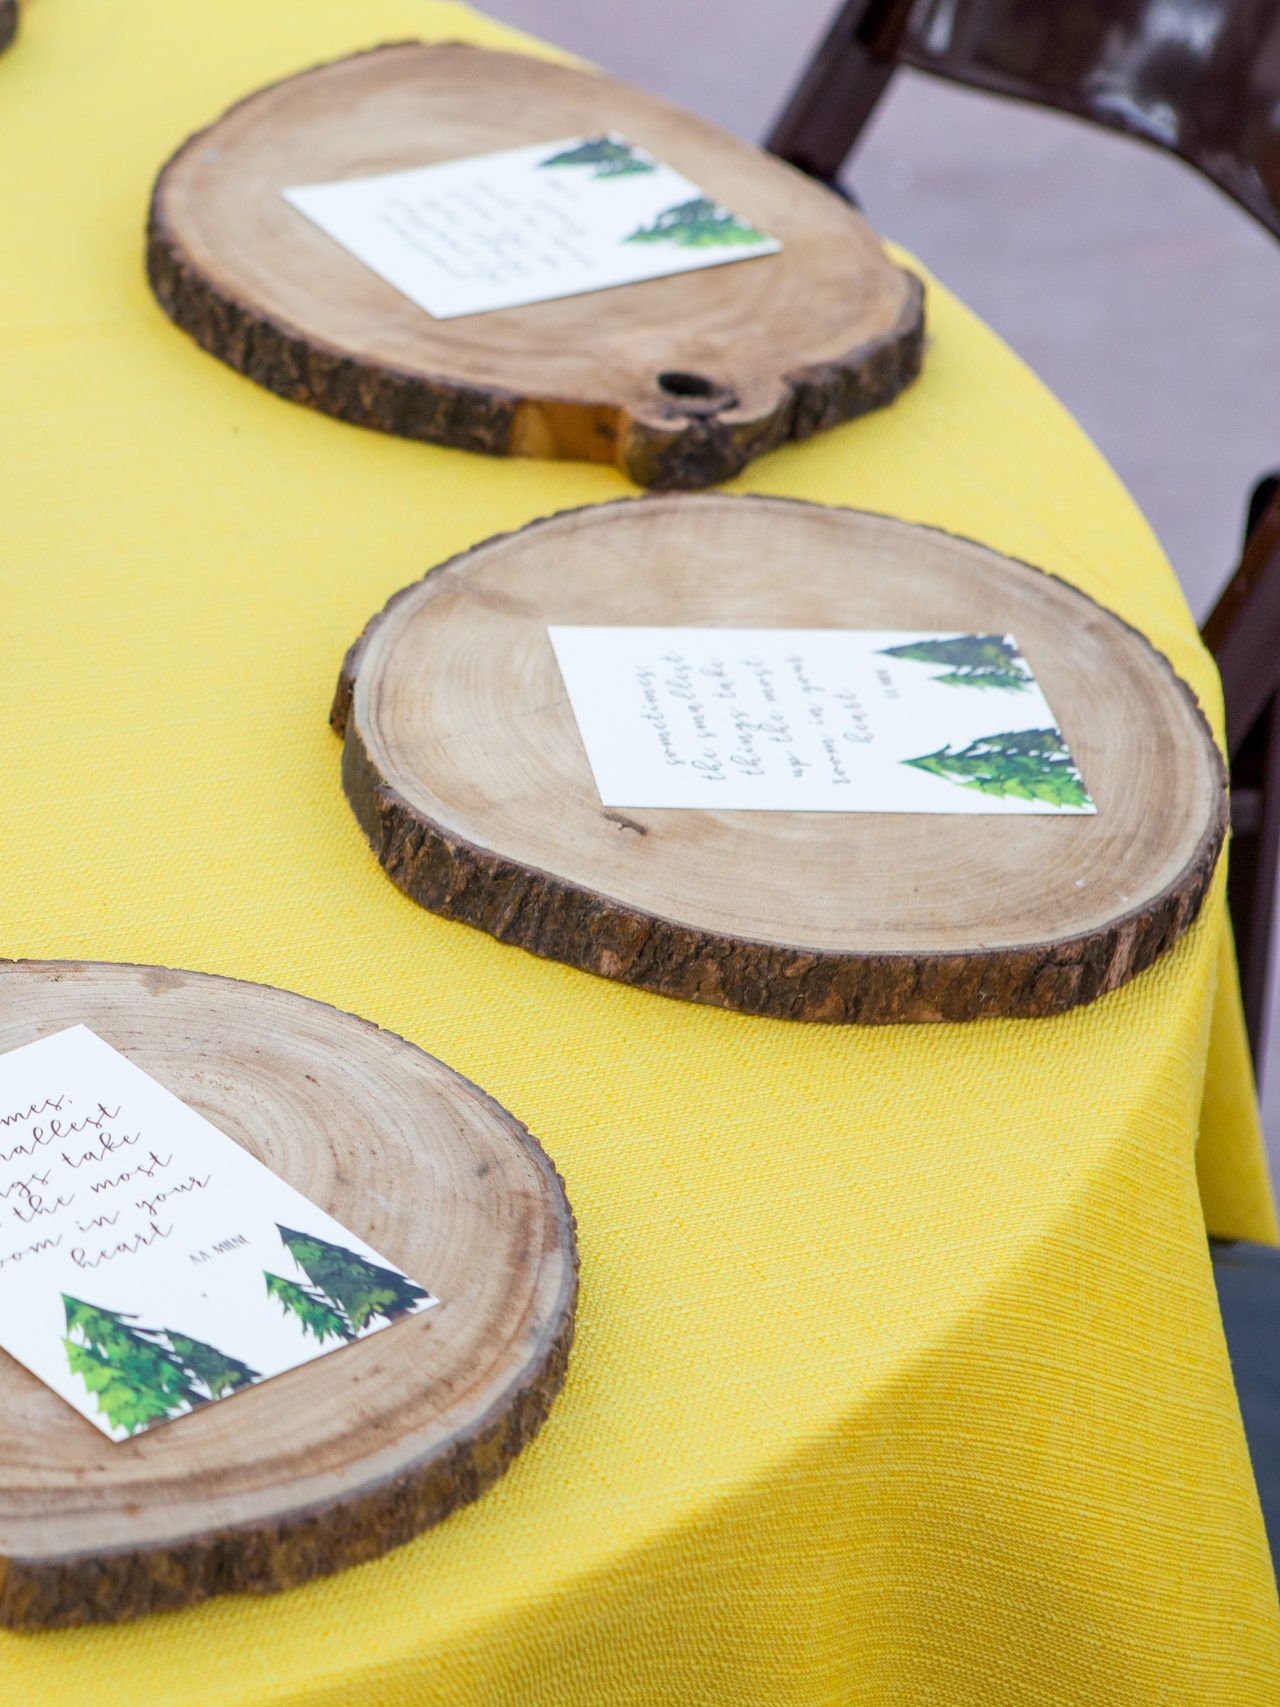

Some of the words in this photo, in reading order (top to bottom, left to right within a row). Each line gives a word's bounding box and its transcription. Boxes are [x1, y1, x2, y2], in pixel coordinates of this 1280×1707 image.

[659, 650, 717, 739] smallest
[699, 658, 736, 699] take
[740, 653, 776, 702] most
[784, 650, 826, 694] your
[758, 708, 793, 743] the
[807, 700, 824, 726] in
[831, 688, 874, 744] heart
[691, 745, 726, 781] the
[729, 705, 765, 776] things
[787, 750, 812, 778] up
[821, 733, 851, 784] room
[62, 1132, 141, 1168] take
[13, 1193, 75, 1223] the
[91, 1151, 173, 1194] most
[75, 1211, 120, 1232] in
[135, 1174, 212, 1216] your
[70, 1221, 174, 1268] heart
